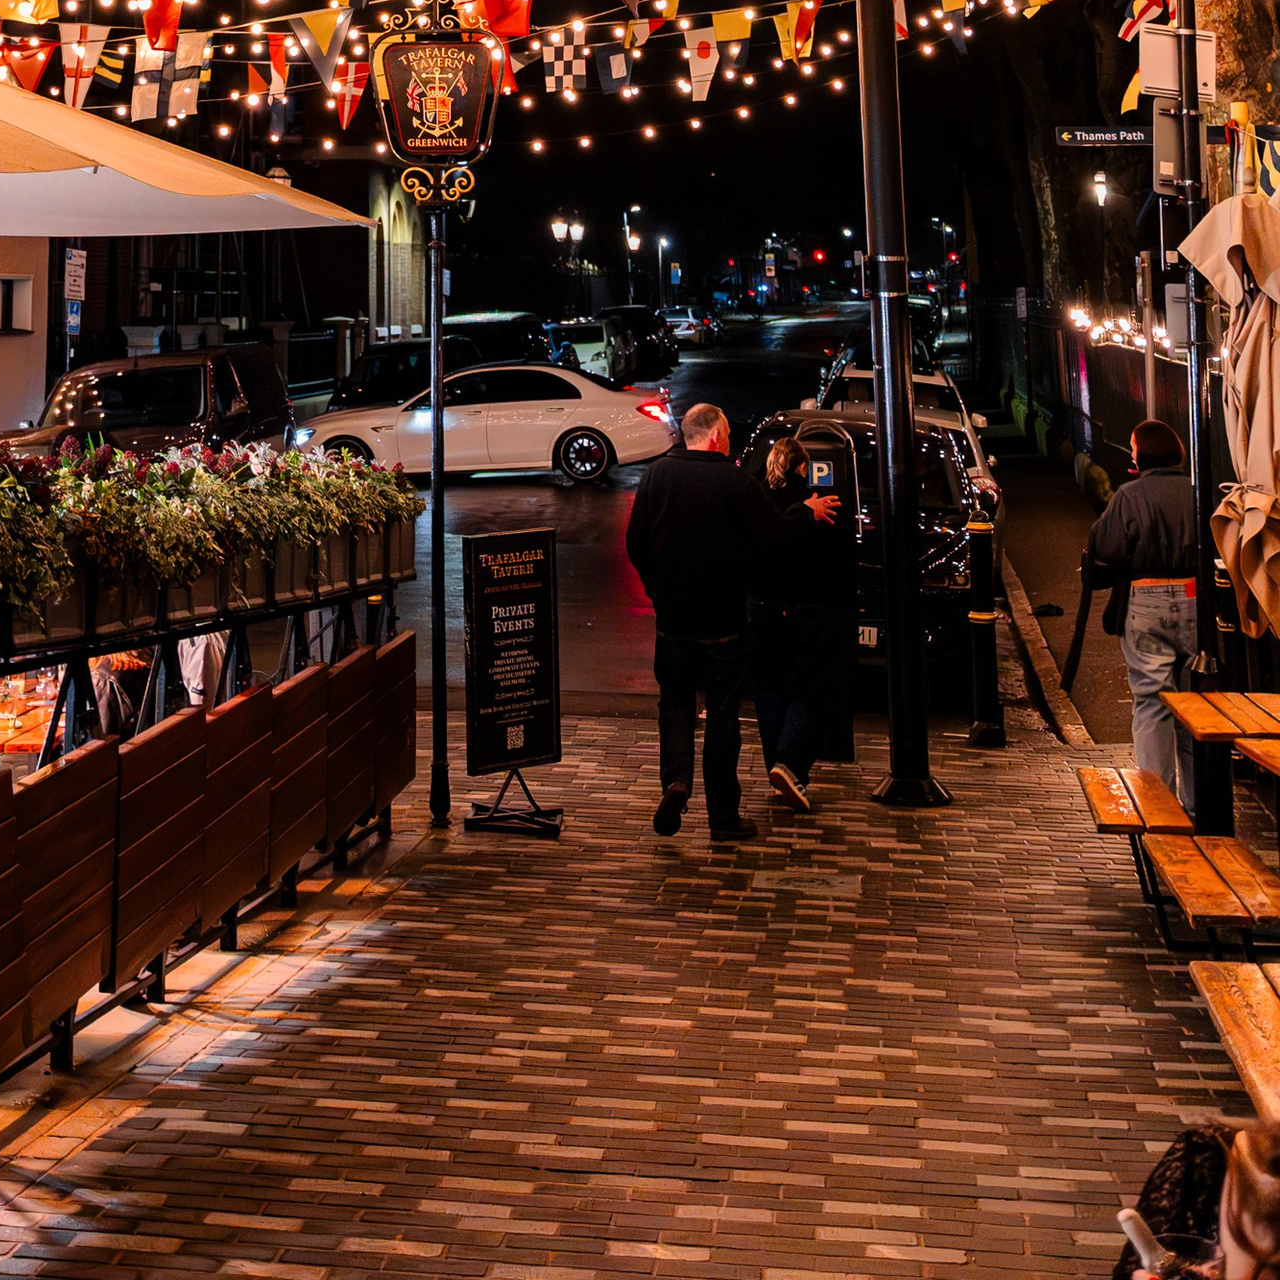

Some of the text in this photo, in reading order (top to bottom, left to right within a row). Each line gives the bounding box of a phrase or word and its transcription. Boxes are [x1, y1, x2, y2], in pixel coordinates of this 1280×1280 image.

[398, 47, 475, 66] TRAFALGAR
[410, 57, 464, 71] TAVERN
[407, 138, 468, 147] GREENWICH
[1074, 131, 1145, 141] Thames Path
[812, 462, 829, 485] P
[479, 549, 545, 567] TRAFALGAR
[491, 564, 534, 579] TAVERN
[491, 603, 536, 619] PRIVATE
[493, 618, 535, 633] EVENTS
